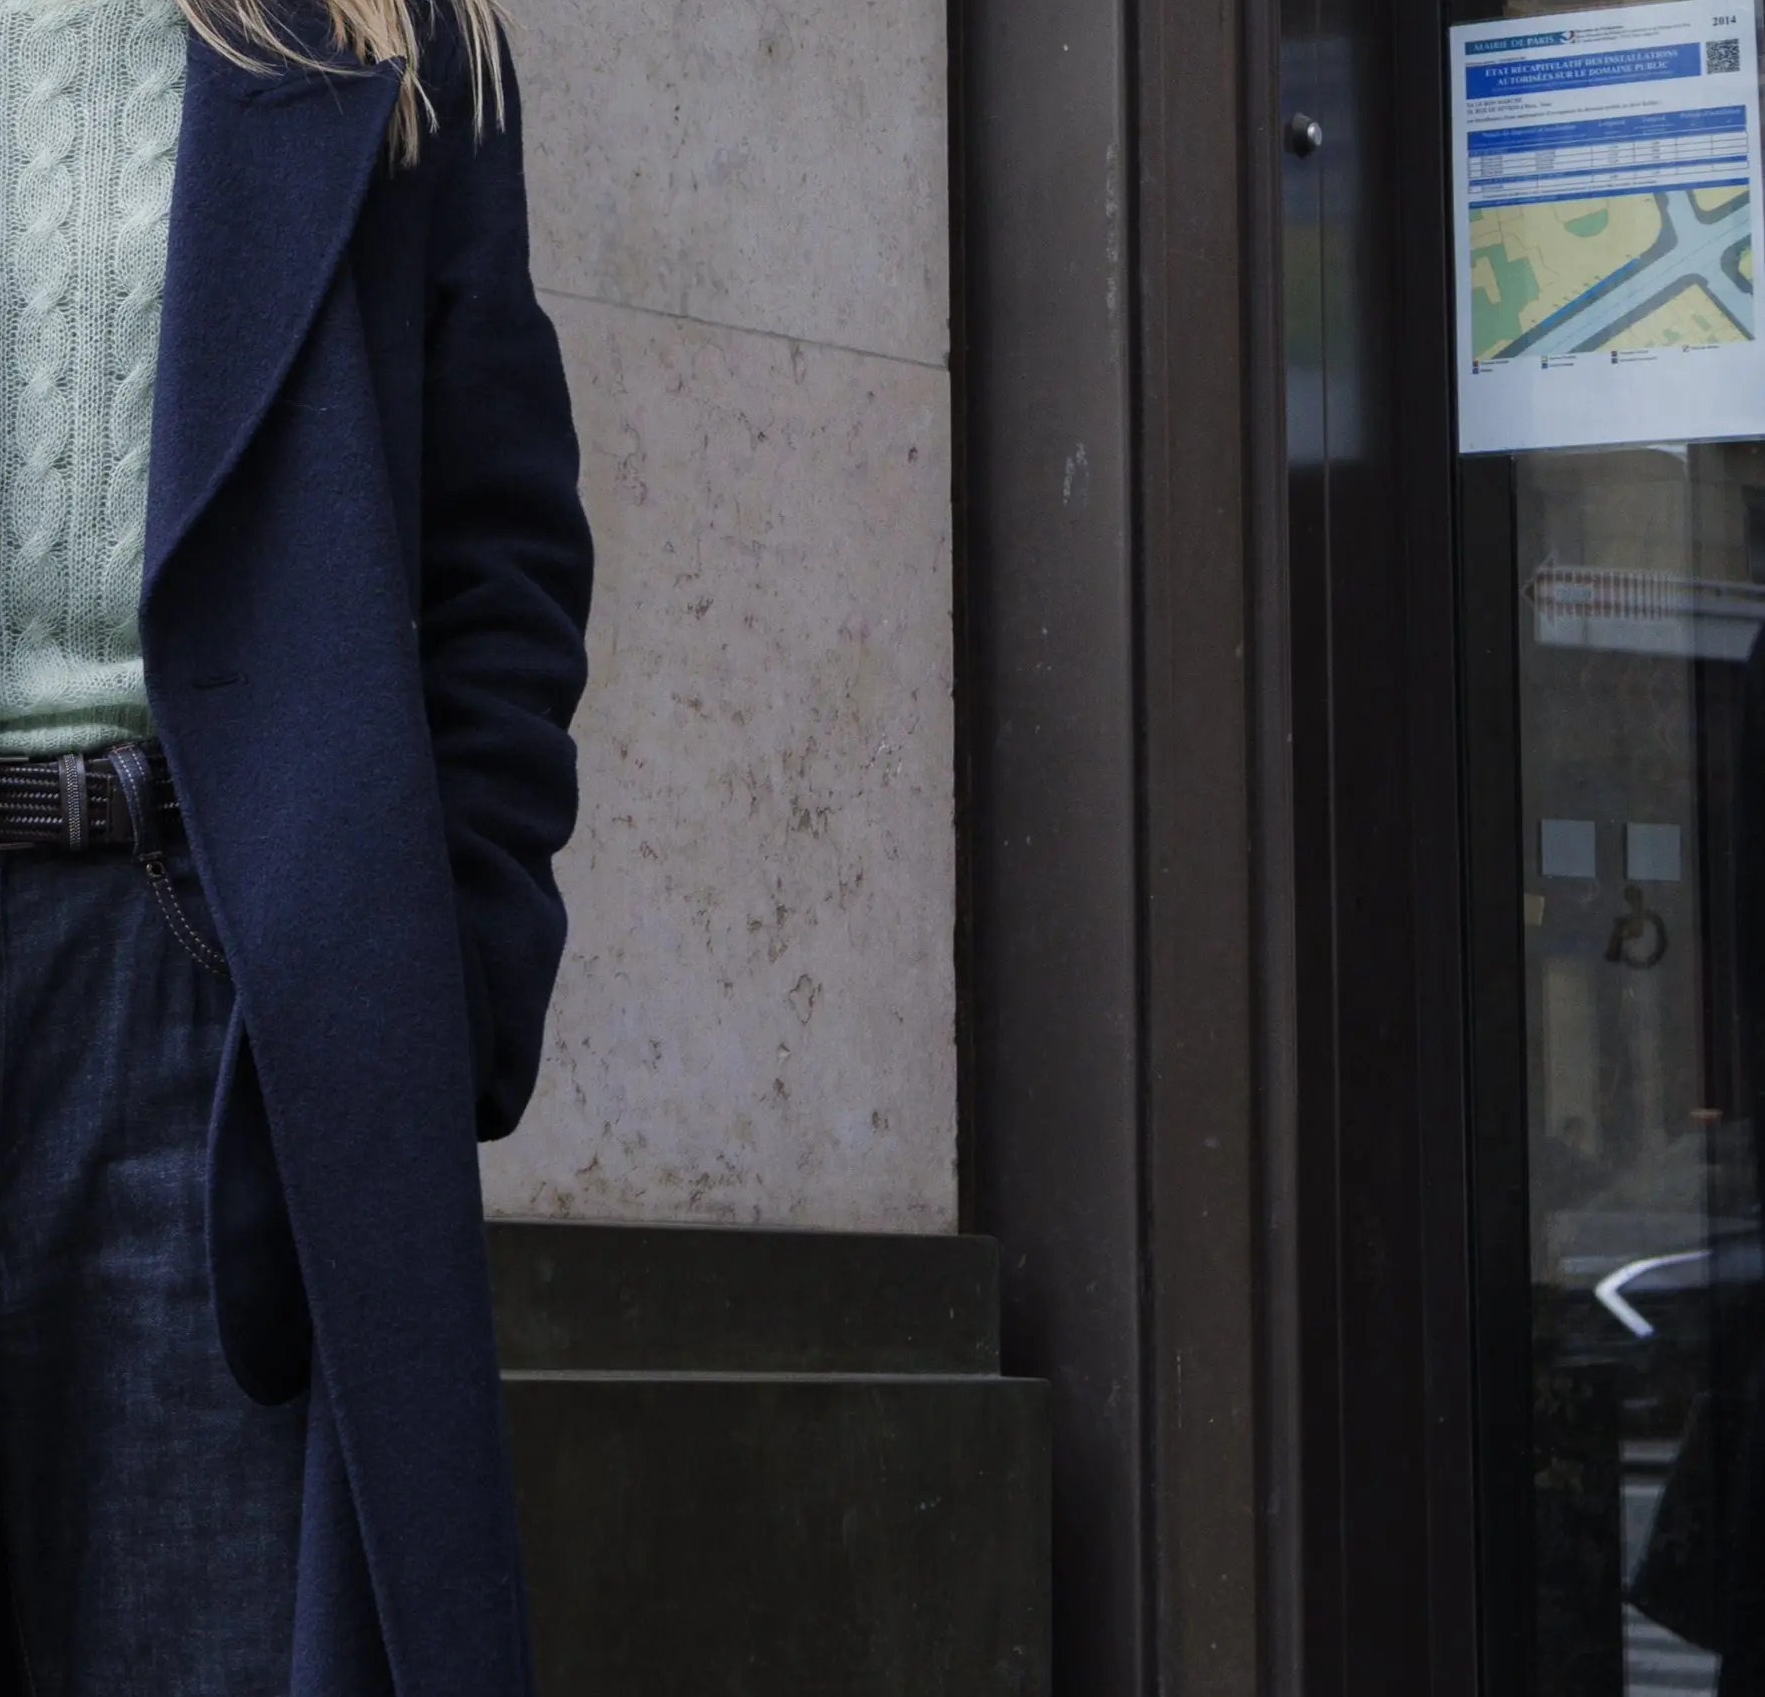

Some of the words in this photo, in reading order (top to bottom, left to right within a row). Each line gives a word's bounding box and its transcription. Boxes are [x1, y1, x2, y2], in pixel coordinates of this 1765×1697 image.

[1712, 15, 1737, 26] 2014
[1474, 40, 1507, 52] MAIRIE
[1511, 39, 1523, 47] DE
[1526, 36, 1554, 46] PARIS
[1585, 57, 1602, 66] DES
[1605, 50, 1678, 65] INSTALLATIONS
[1556, 71, 1574, 80] SUR
[1575, 70, 1586, 78] LE
[1589, 64, 1633, 76] DOMAINE
[1635, 61, 1669, 71] PUBLIC
